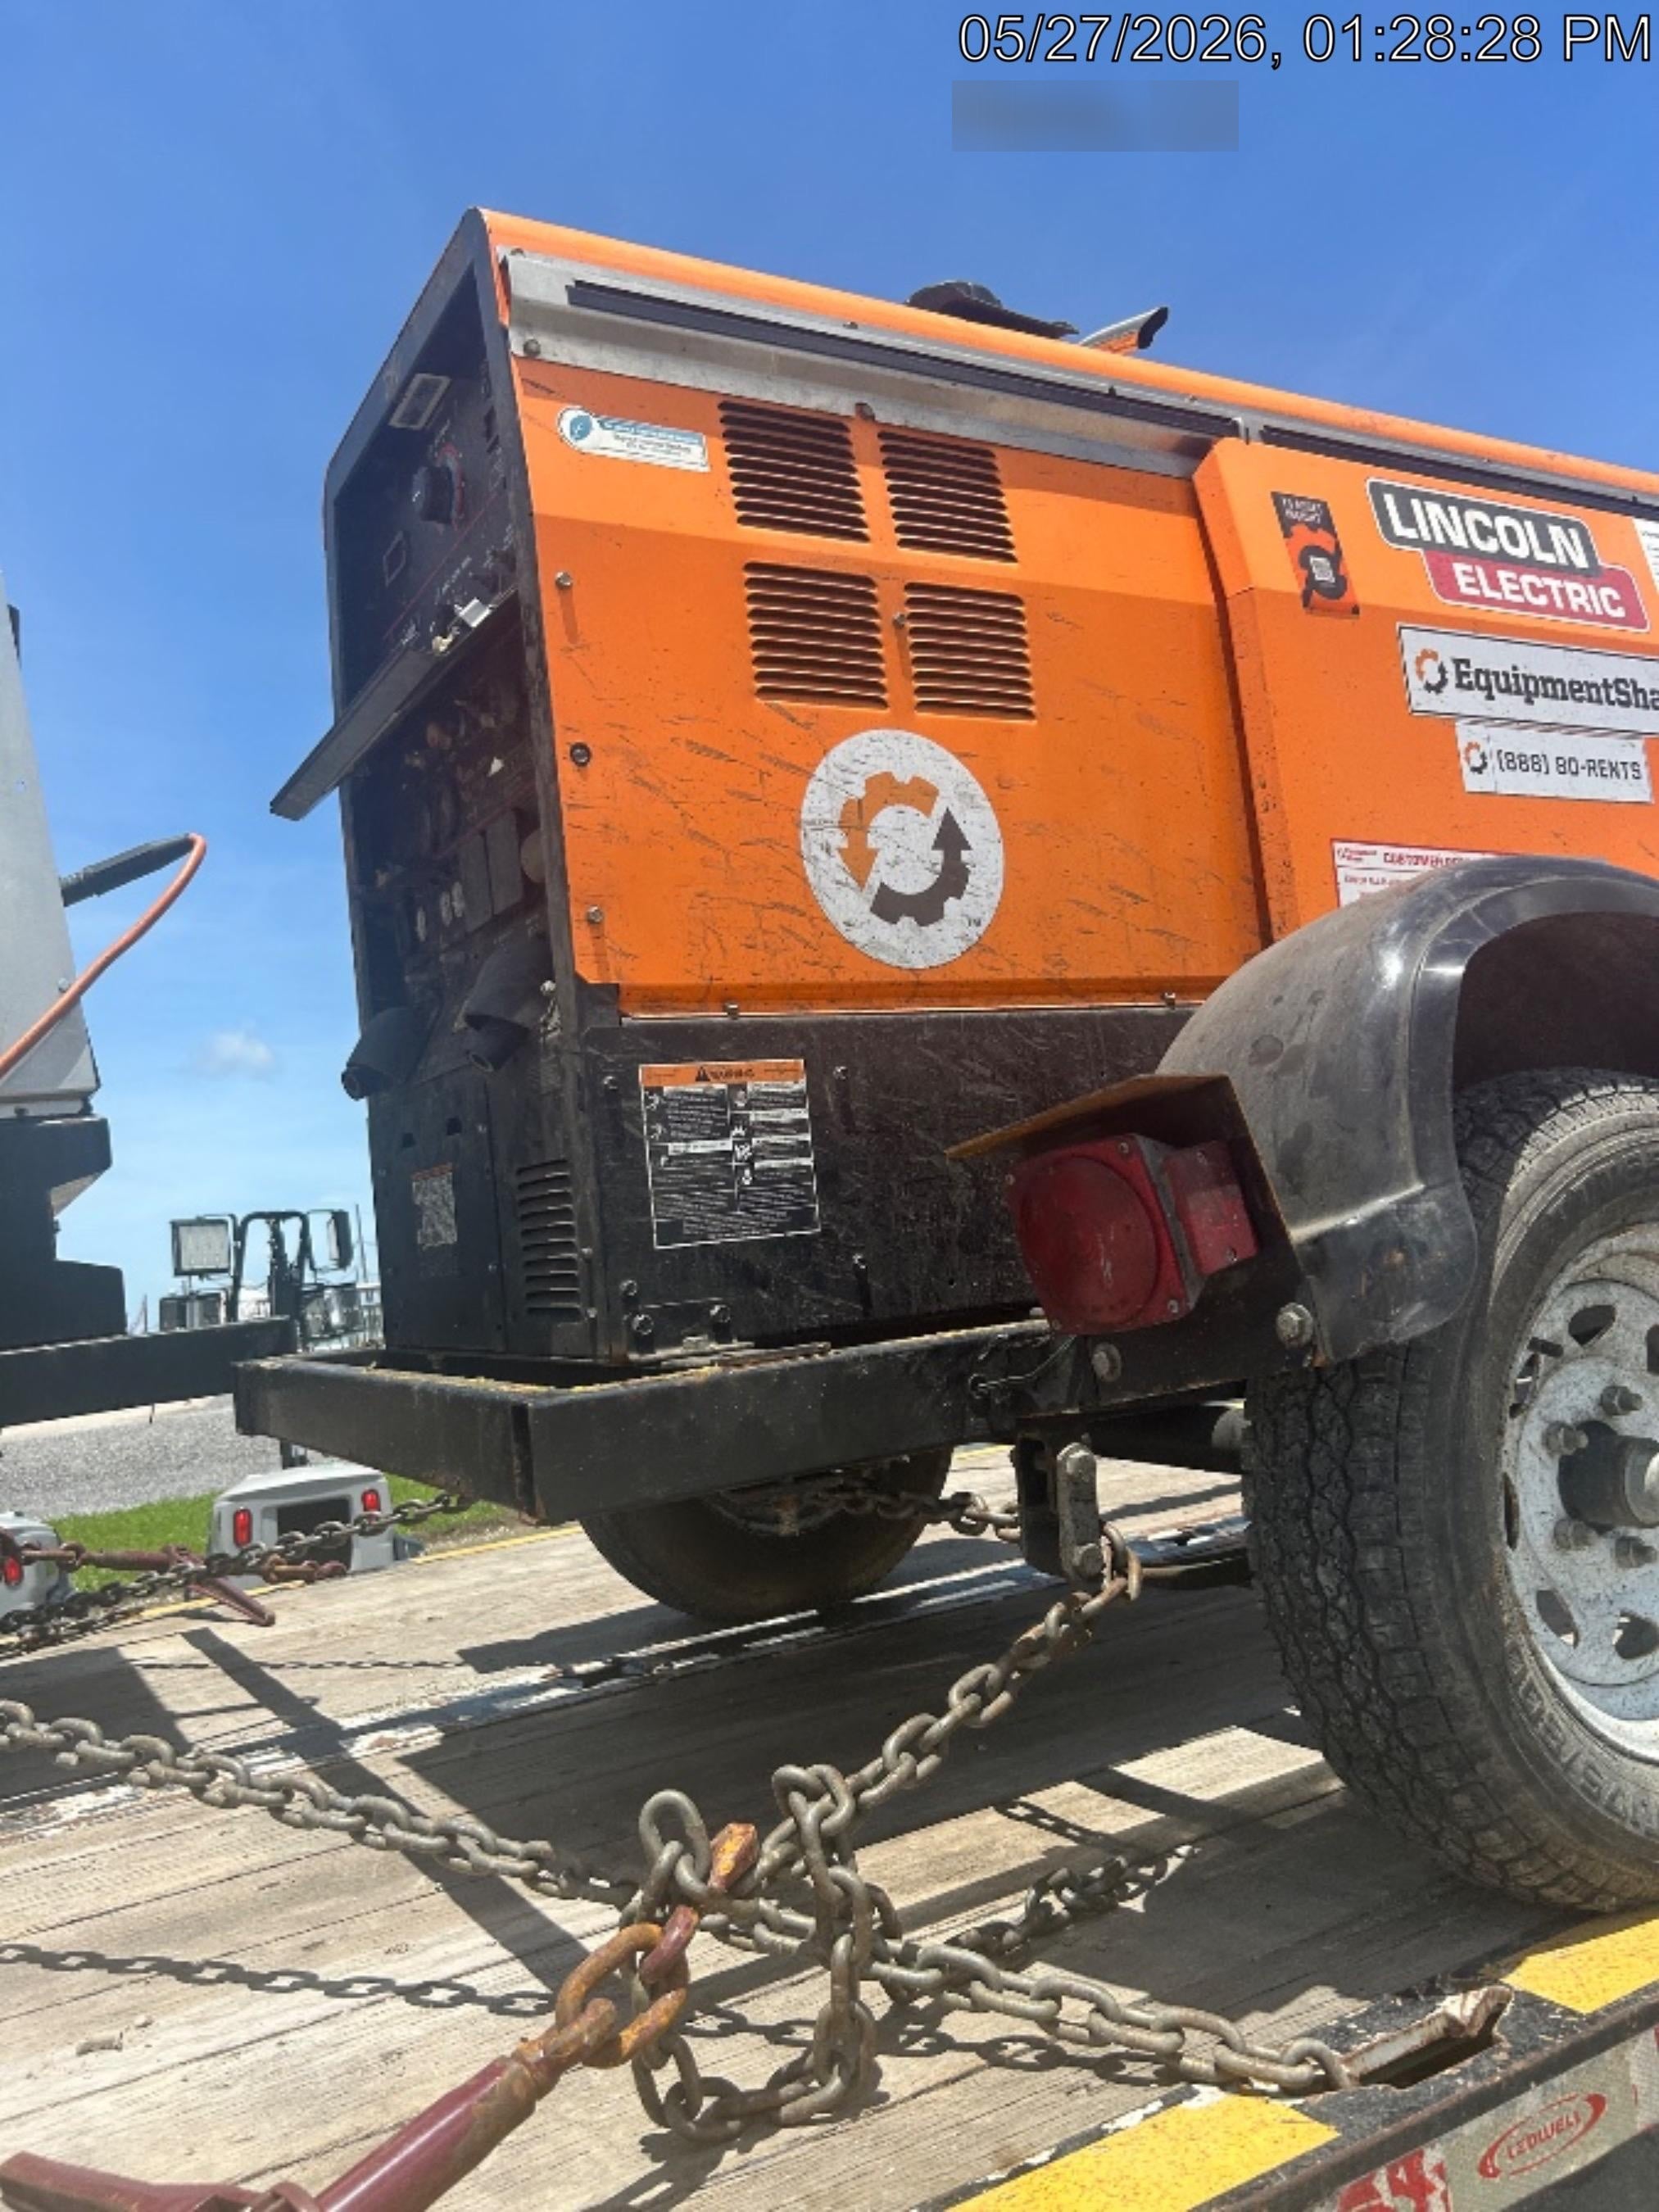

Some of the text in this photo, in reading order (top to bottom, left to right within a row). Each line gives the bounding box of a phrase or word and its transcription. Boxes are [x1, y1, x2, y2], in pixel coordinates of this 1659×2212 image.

[1383, 493, 1589, 569] LINCOLN
[1453, 561, 1625, 619] ELECTRIC
[1497, 749, 1550, 775] (888)
